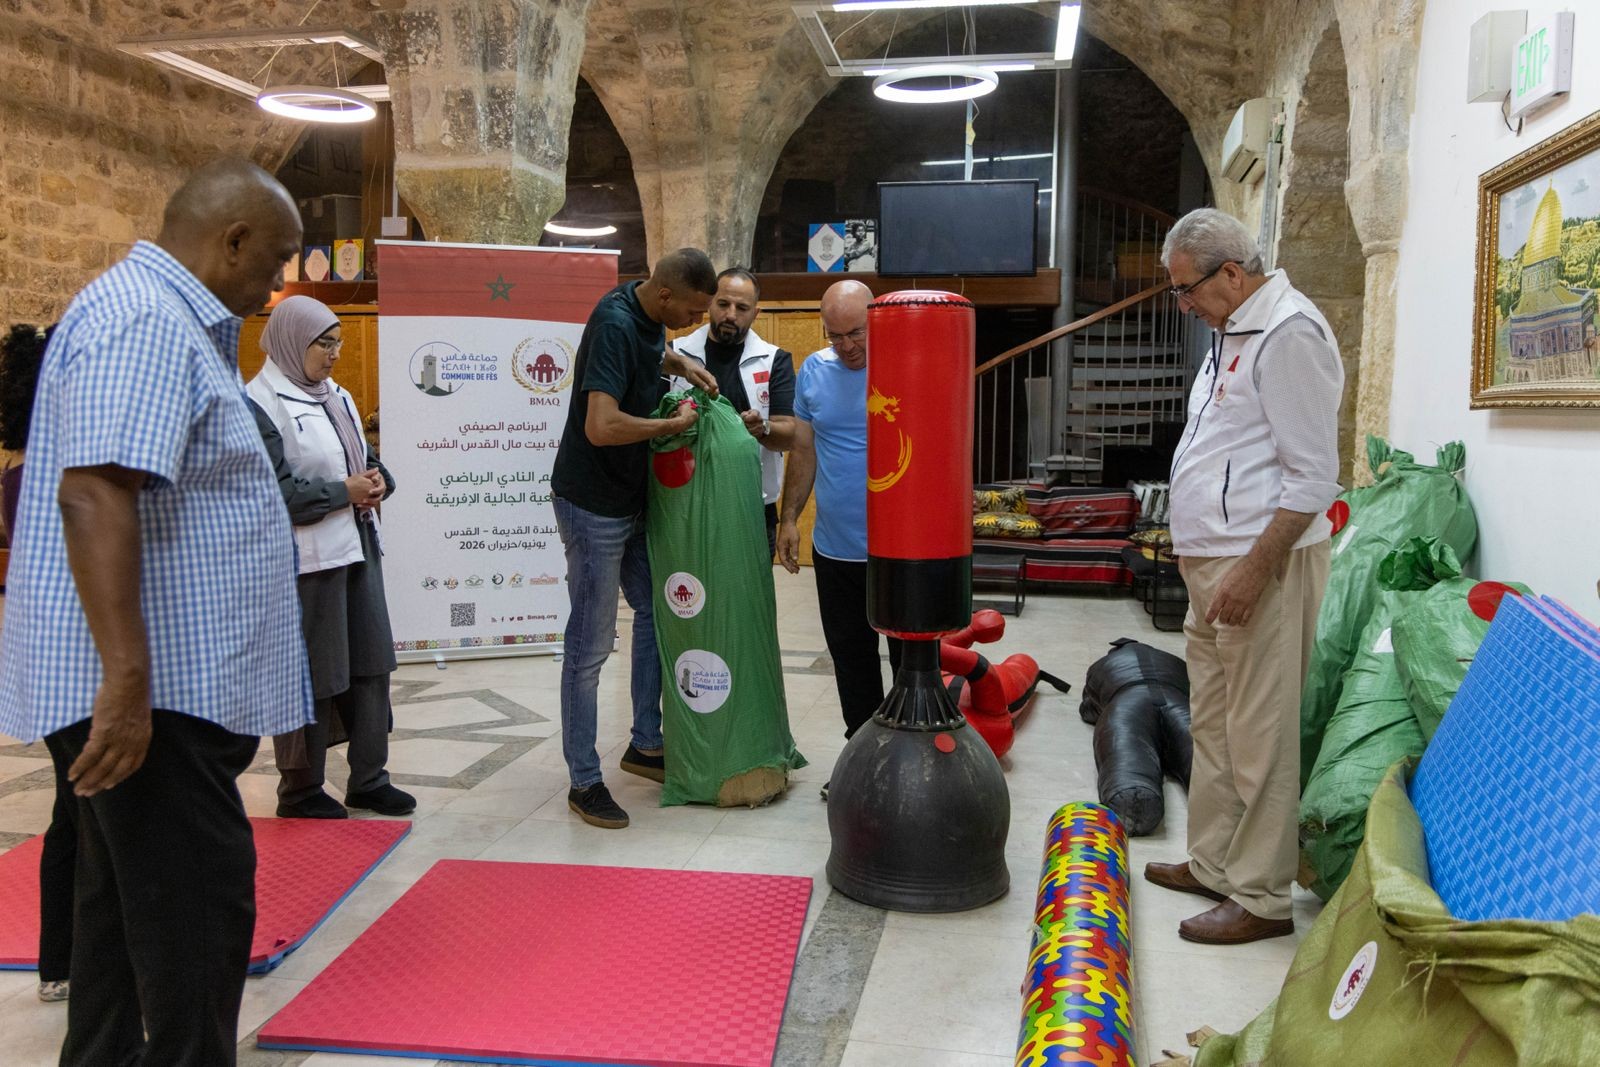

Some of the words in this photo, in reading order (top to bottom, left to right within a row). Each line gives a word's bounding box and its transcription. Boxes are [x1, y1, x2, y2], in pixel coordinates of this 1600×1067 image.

[1517, 27, 1547, 97] EXIT
[441, 353, 466, 363] فاس
[469, 353, 498, 363] جماعة
[485, 371, 498, 380] FÈS
[529, 397, 560, 406] BMAQ
[459, 421, 504, 436] الصيفي
[507, 421, 547, 434] البرنامج
[416, 437, 457, 451] الشريف
[461, 439, 499, 451] القدس
[502, 439, 521, 451] مال
[524, 441, 546, 451] بيت
[440, 471, 493, 489] الرياضي
[497, 471, 534, 489] النادي
[425, 493, 479, 508] الإفريقية
[483, 492, 526, 507] الجالية
[444, 527, 479, 539] القدس
[492, 526, 530, 536] القديمة
[459, 541, 485, 550] 2026
[487, 540, 546, 551] يونيو/حزيران
